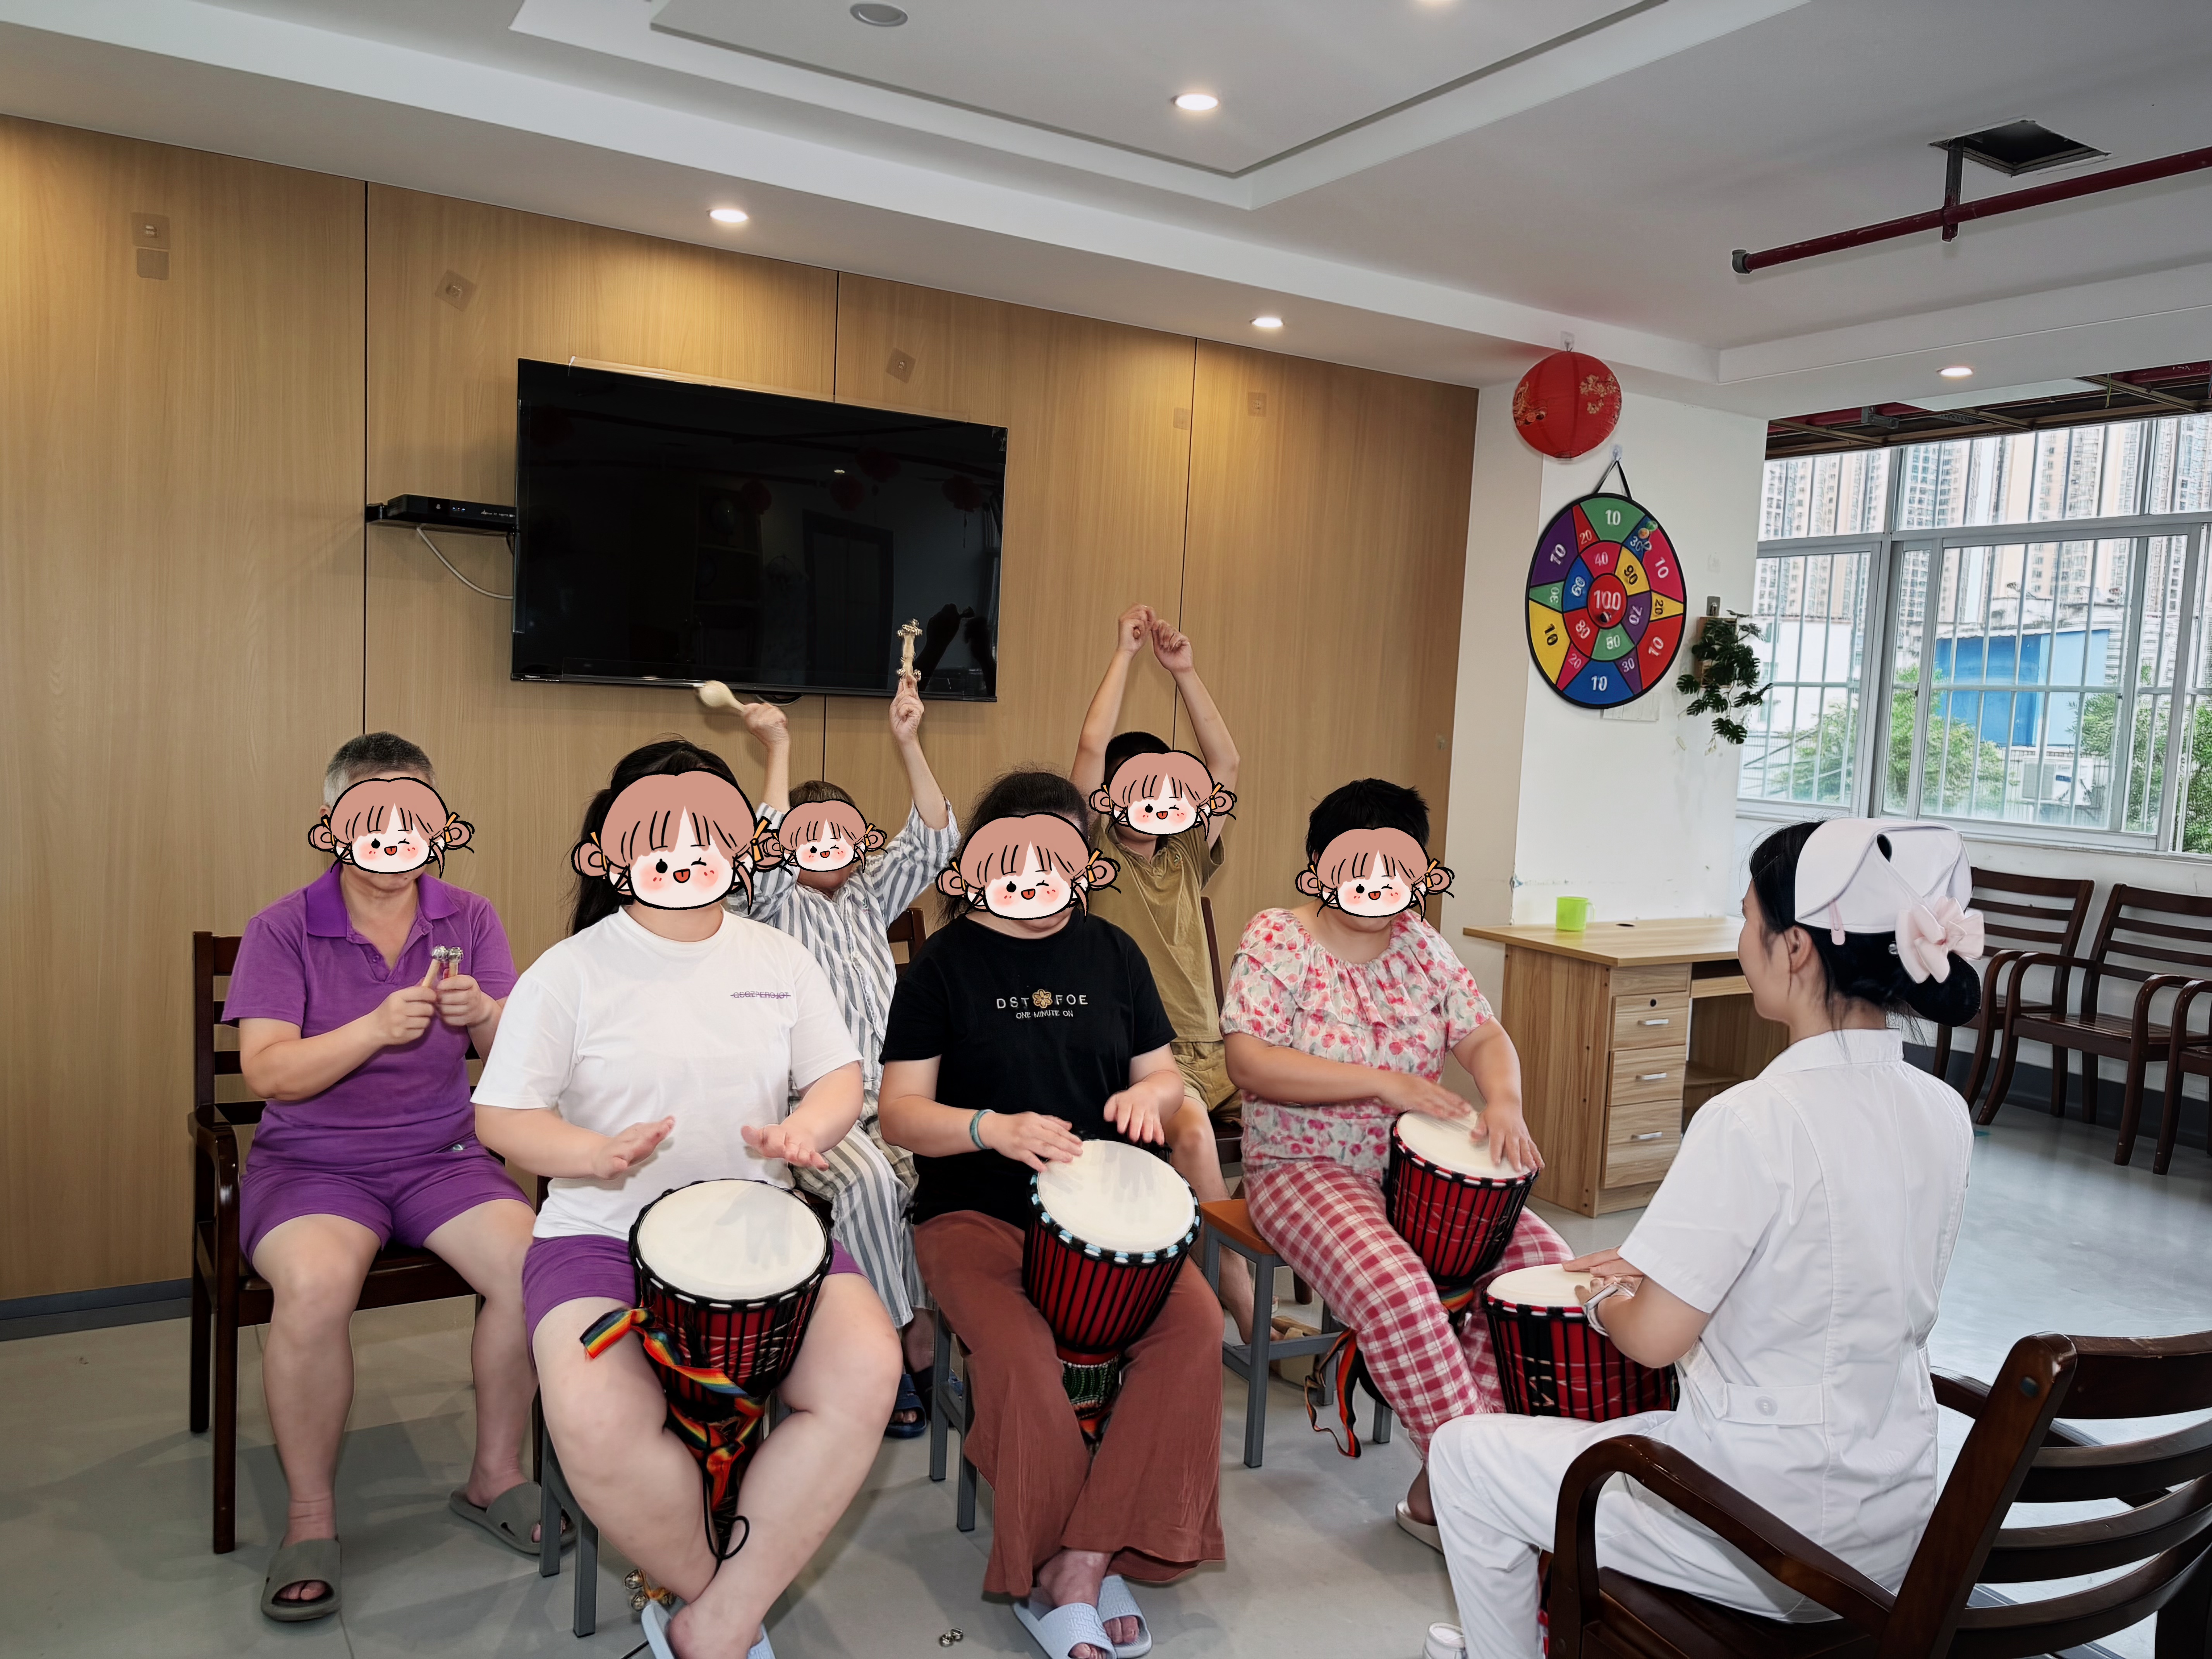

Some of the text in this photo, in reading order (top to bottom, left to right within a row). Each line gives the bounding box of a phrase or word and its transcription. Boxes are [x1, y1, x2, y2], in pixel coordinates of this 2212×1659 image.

[1605, 509, 1621, 526] 10
[1580, 530, 1592, 544] 20
[1550, 544, 1566, 565] 10
[1594, 552, 1608, 566] 40
[1624, 565, 1638, 585] 90
[1655, 557, 1669, 578] 10
[1571, 576, 1585, 597] 60
[1550, 587, 1560, 603] 30
[1594, 590, 1621, 611] 100
[1629, 605, 1643, 625] 70
[1655, 599, 1664, 615] 20
[1544, 623, 1558, 646] 10
[1576, 620, 1590, 639] 80
[1606, 635, 1621, 650] 50
[1649, 636, 1664, 657] 10
[1568, 653, 1582, 669] 20
[1622, 658, 1635, 673] 30
[1591, 676, 1608, 691] 10
[996, 994, 1088, 1009] DST FOE
[1034, 1010, 1060, 1018] MINUTE
